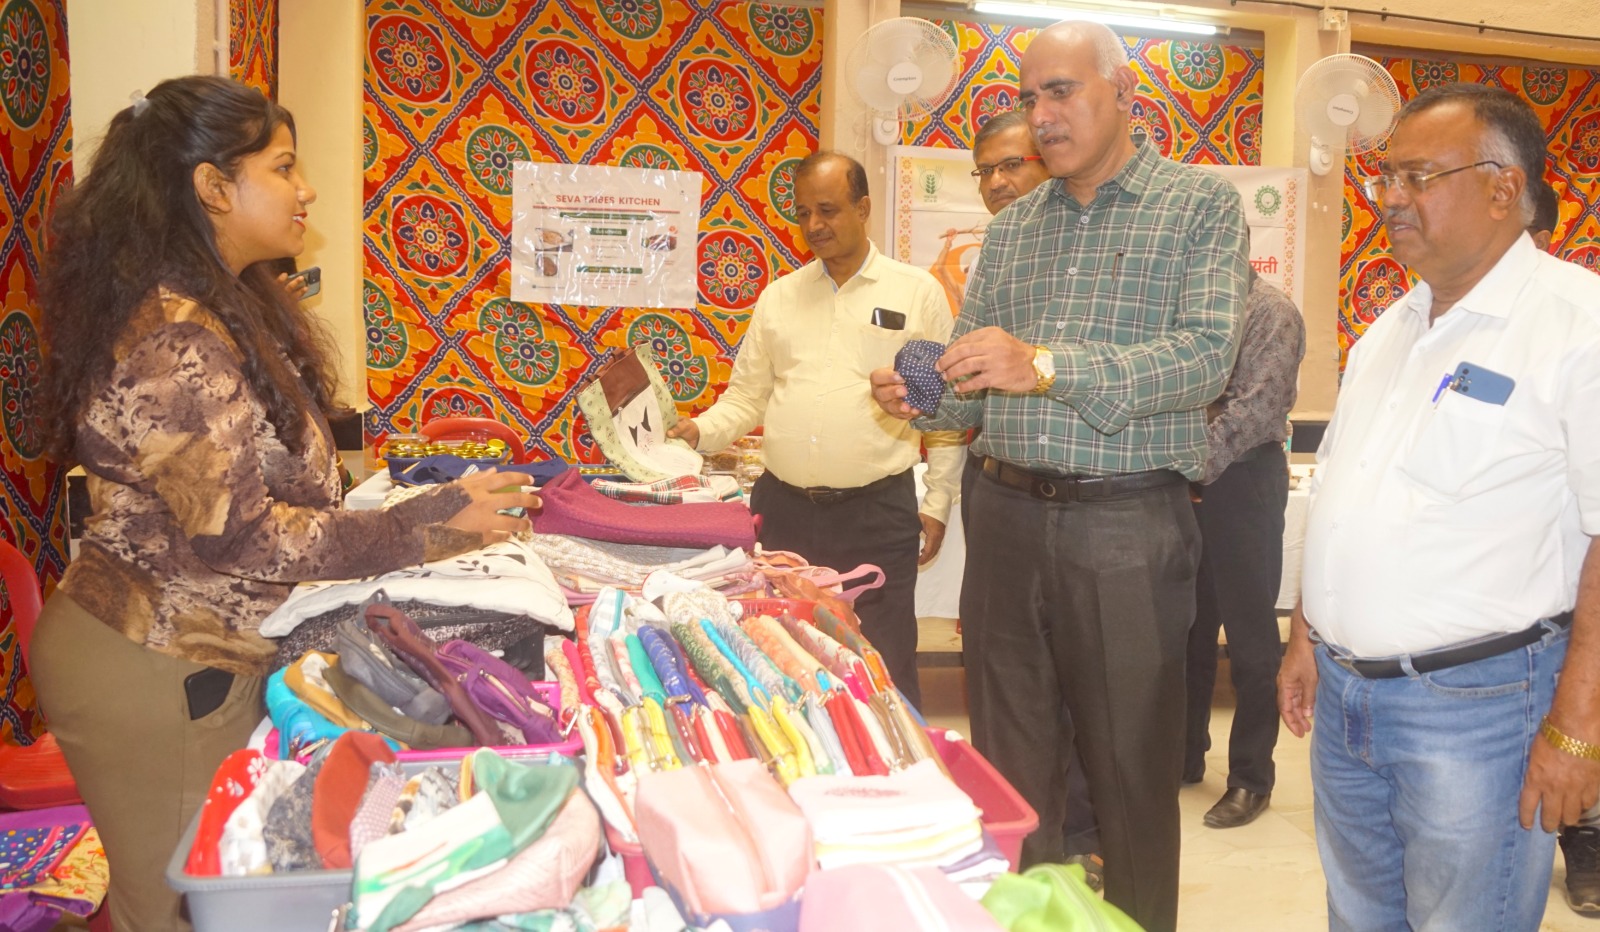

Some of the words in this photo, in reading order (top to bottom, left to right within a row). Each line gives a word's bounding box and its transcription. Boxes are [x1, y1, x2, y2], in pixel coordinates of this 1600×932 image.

[556, 194, 581, 204] SEVA
[618, 197, 661, 207] KITCHEN
[1249, 256, 1278, 274] यंती
